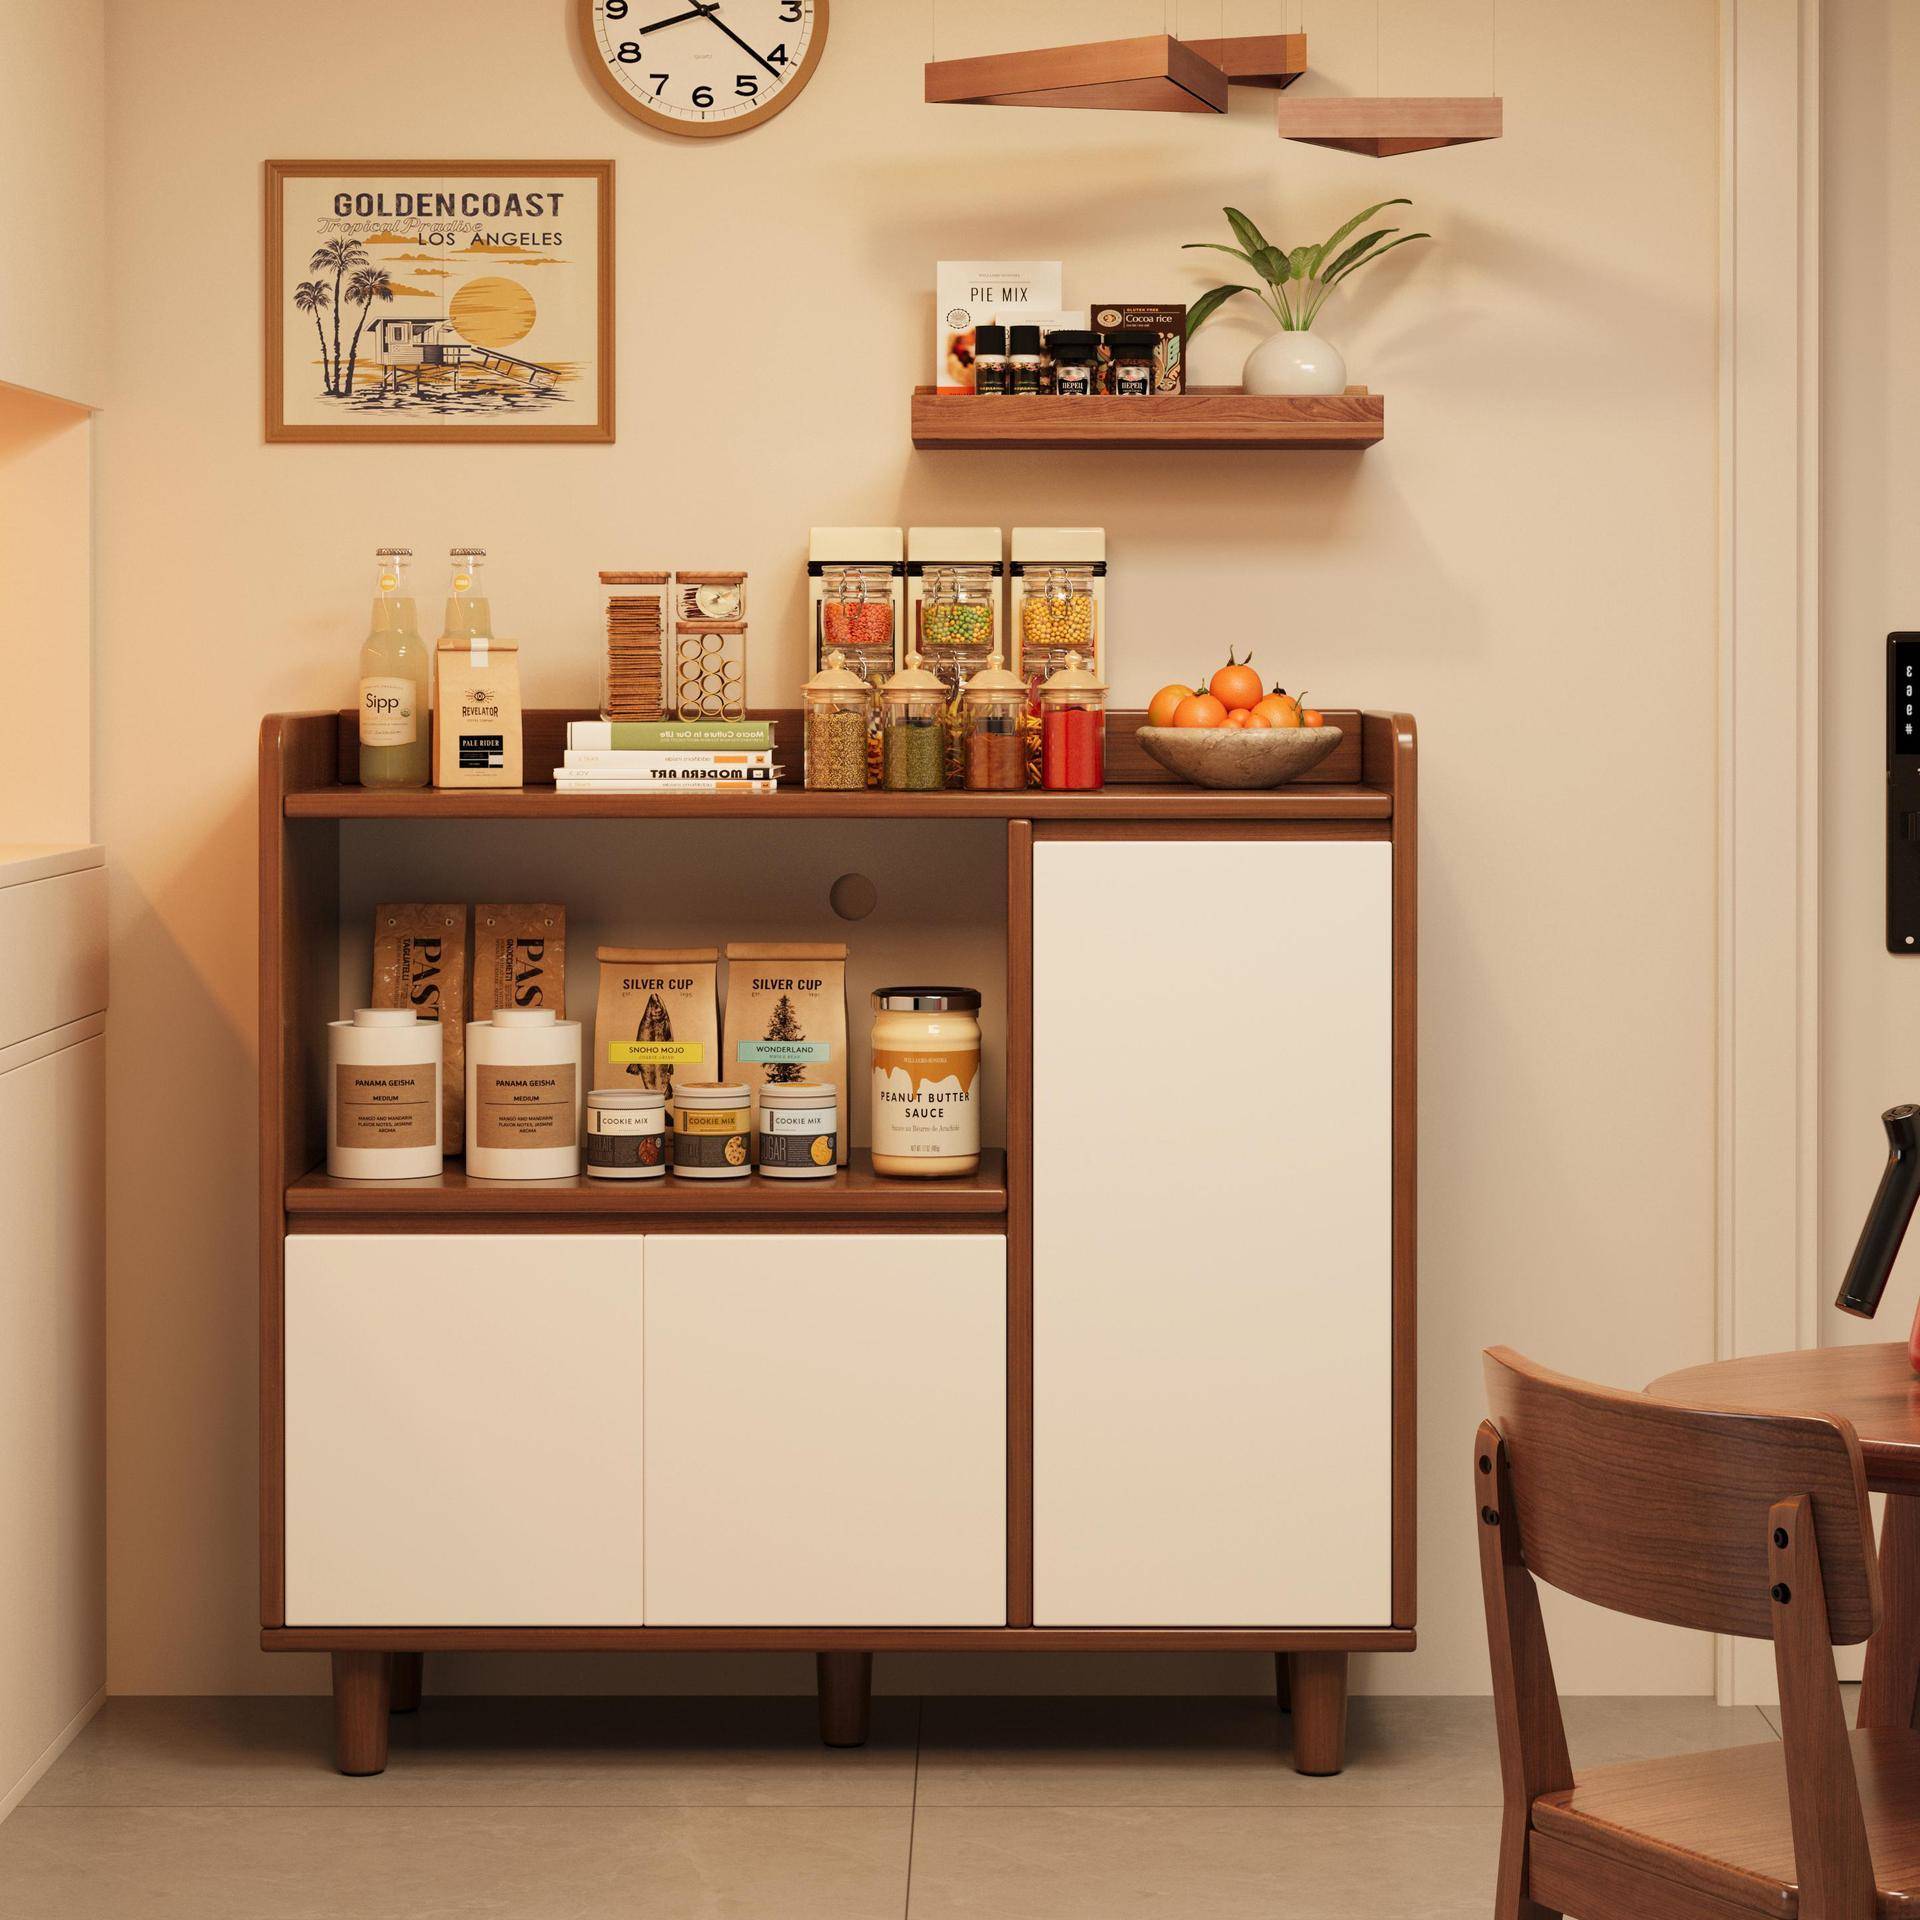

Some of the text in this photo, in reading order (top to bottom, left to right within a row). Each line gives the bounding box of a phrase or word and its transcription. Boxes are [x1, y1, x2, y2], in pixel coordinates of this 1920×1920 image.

[605, 0, 629, 20] 9
[778, 0, 803, 23] 3
[617, 41, 642, 64] 8
[766, 43, 789, 66] 4
[649, 73, 670, 96] 7
[734, 75, 759, 97] 5
[691, 86, 715, 108] 6
[316, 217, 400, 236] Tropical
[418, 232, 563, 246] LOS ANGELES
[970, 287, 1028, 302] PIE MIX
[1125, 314, 1173, 323] Cocoa rice
[366, 692, 399, 714] Sipp
[462, 706, 499, 718] REVELATOR
[462, 739, 500, 747] PALE RIDER
[402, 939, 411, 981] TAGLIATELLI
[623, 978, 694, 990] SILVER CUP
[752, 978, 823, 991] SILVER CUP
[628, 1046, 685, 1054] SNOHO MOJO
[756, 1046, 814, 1054] WONDERLAND
[355, 1079, 416, 1087] PANAMA GEISHA
[495, 1079, 556, 1087] PANAMA GEISHA
[880, 1091, 970, 1103] PEANUT BUTTER
[905, 1108, 944, 1118] SAUCE
[689, 1117, 736, 1125] COOKIE MIX
[775, 1117, 822, 1125] COOKIE MIX
